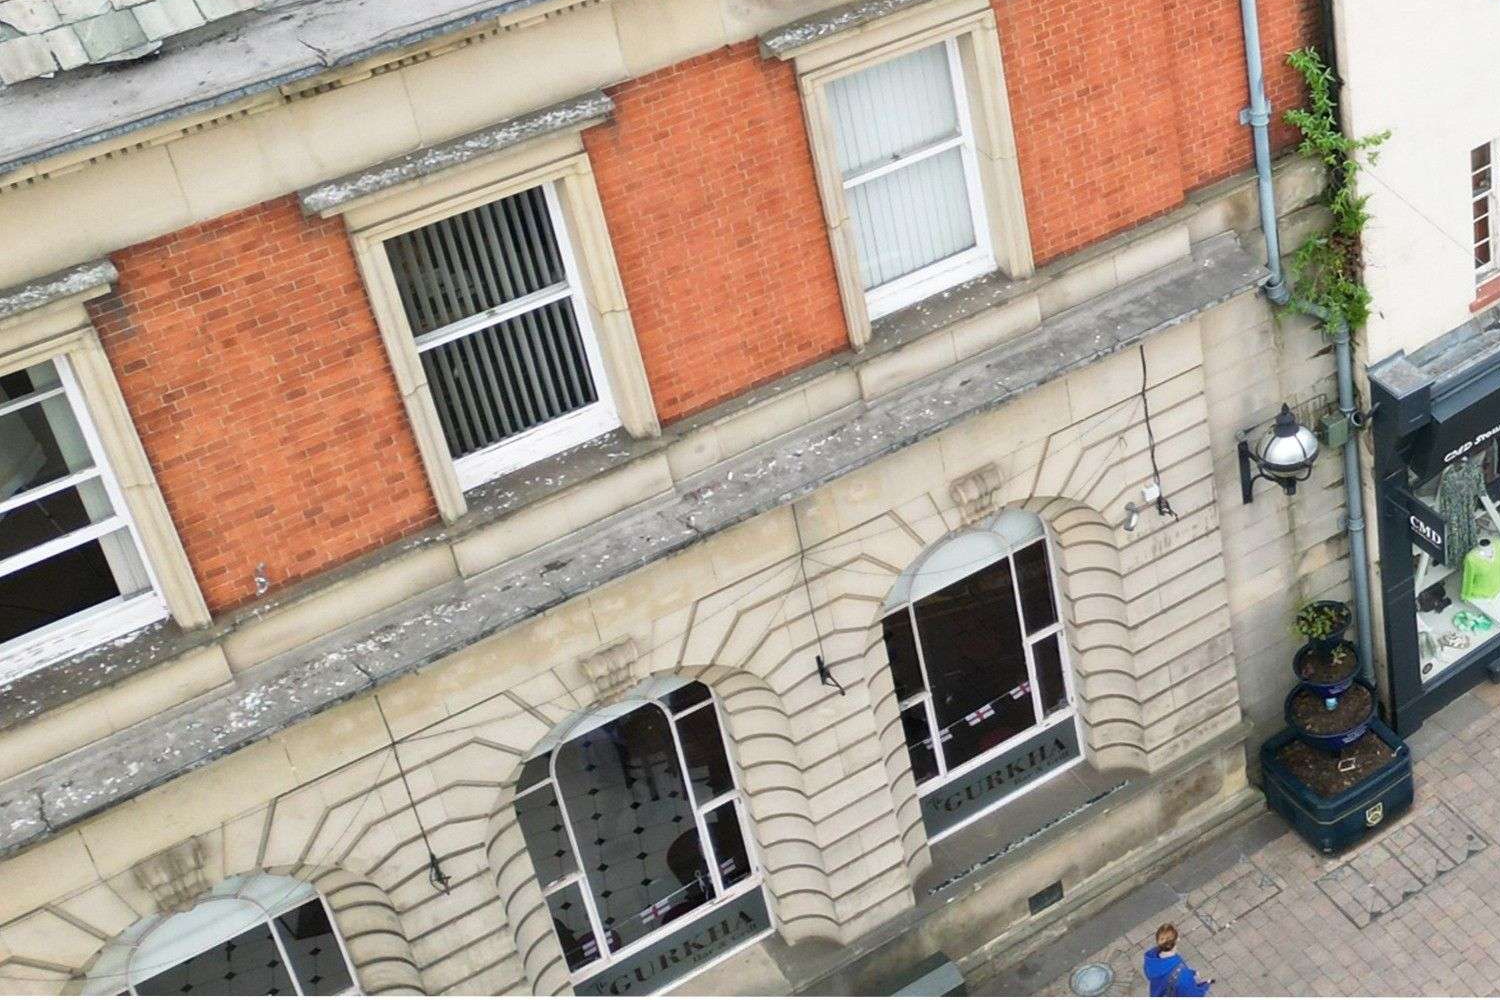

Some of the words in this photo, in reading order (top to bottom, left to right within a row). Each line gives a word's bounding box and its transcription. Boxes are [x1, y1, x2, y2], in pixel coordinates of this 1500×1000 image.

[1444, 441, 1473, 462] CMD
[1410, 516, 1442, 544] CMD
[944, 737, 1067, 812] GURKHA
[610, 910, 753, 995] GURKHA
